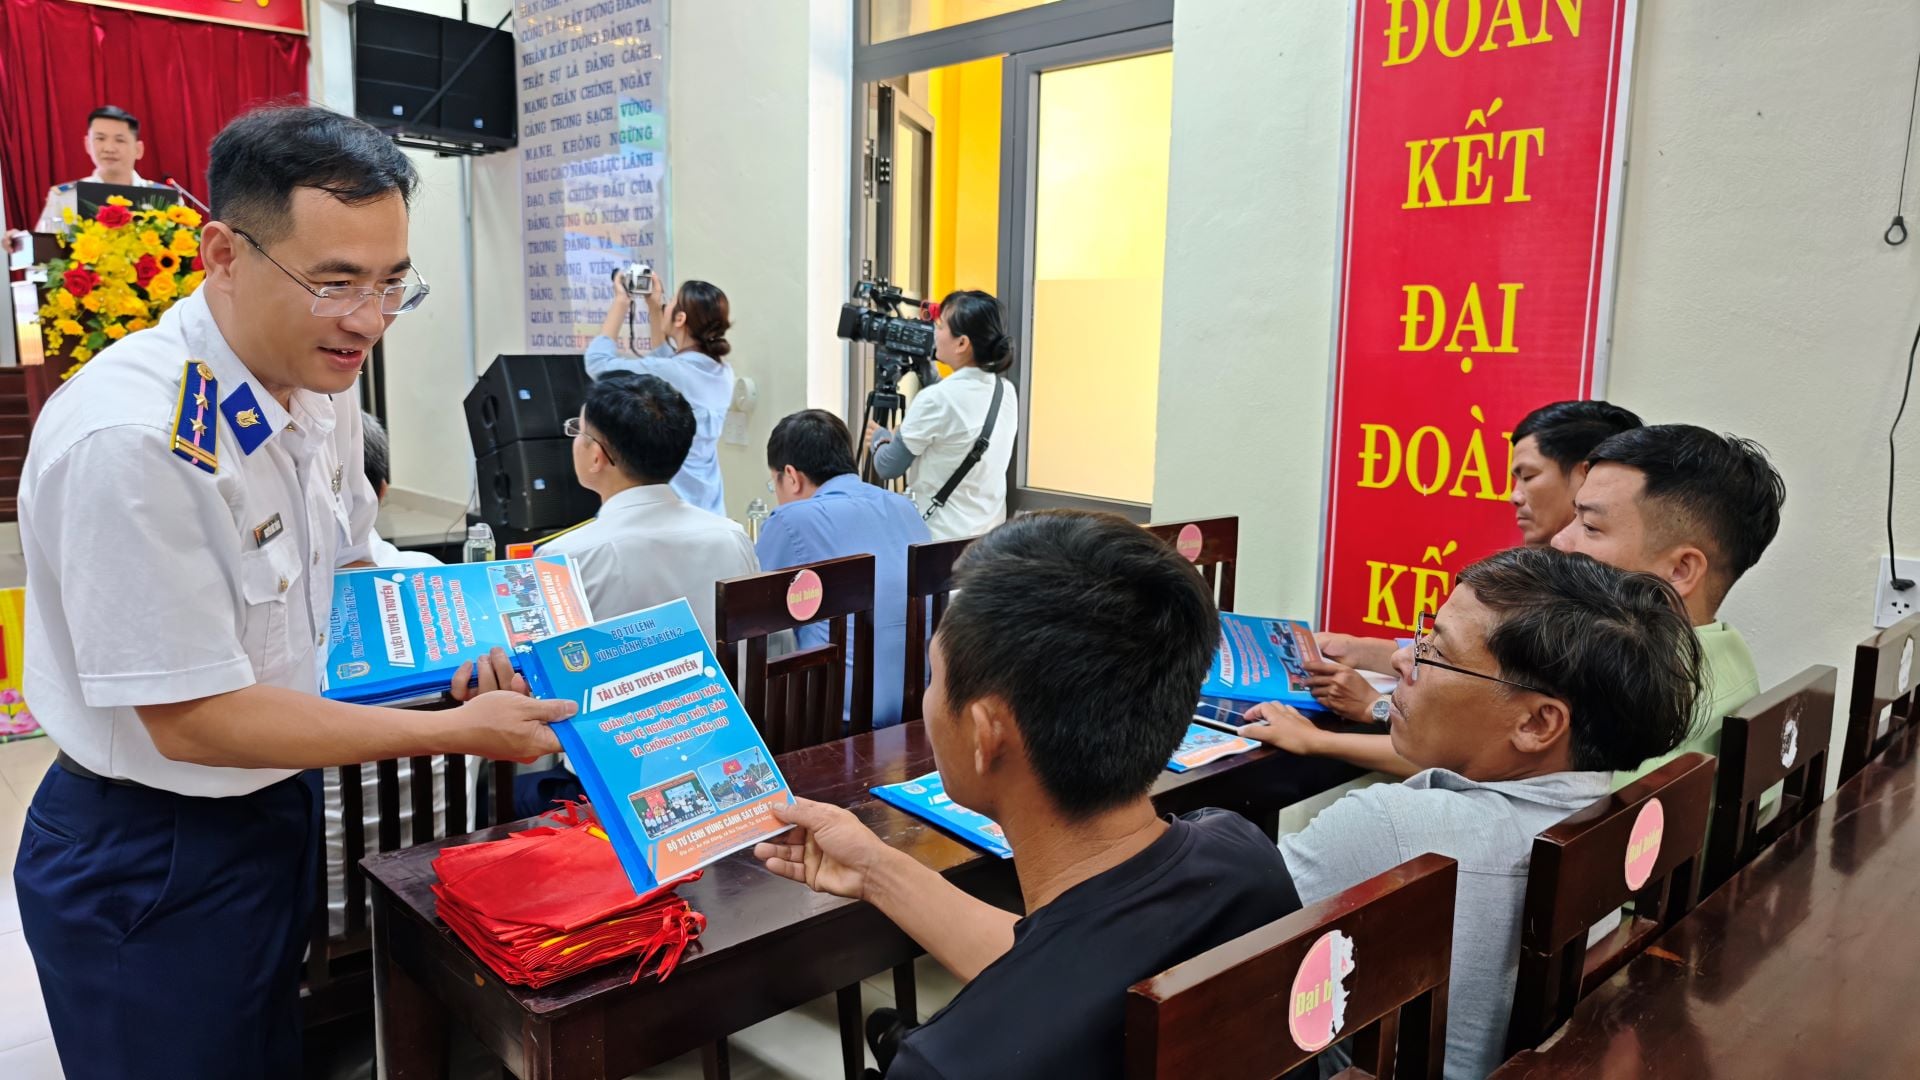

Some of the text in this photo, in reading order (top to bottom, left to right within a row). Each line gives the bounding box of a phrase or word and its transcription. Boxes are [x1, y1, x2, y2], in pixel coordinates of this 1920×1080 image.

[602, 20, 632, 42] ĐẢNG
[636, 18, 652, 33] TA
[566, 60, 579, 79] LÀ
[585, 52, 615, 74] ĐẢNG
[1401, 97, 1545, 209] KẾT
[631, 174, 653, 195] CỦA
[634, 206, 654, 221] TIN
[527, 240, 557, 254] TRONG
[598, 232, 613, 250] VÀ
[1398, 281, 1525, 374] ĐẠI
[1357, 404, 1514, 502] ĐOÀ
[1362, 540, 1458, 634] KẾ
[380, 585, 406, 658] TÀI LIỆU TUYÊN TRUYỀN
[596, 659, 698, 702] TÀI LIỆU TUYÊN TRUYỀN
[681, 691, 701, 708] KHAI
[672, 728, 692, 745] KHAI
